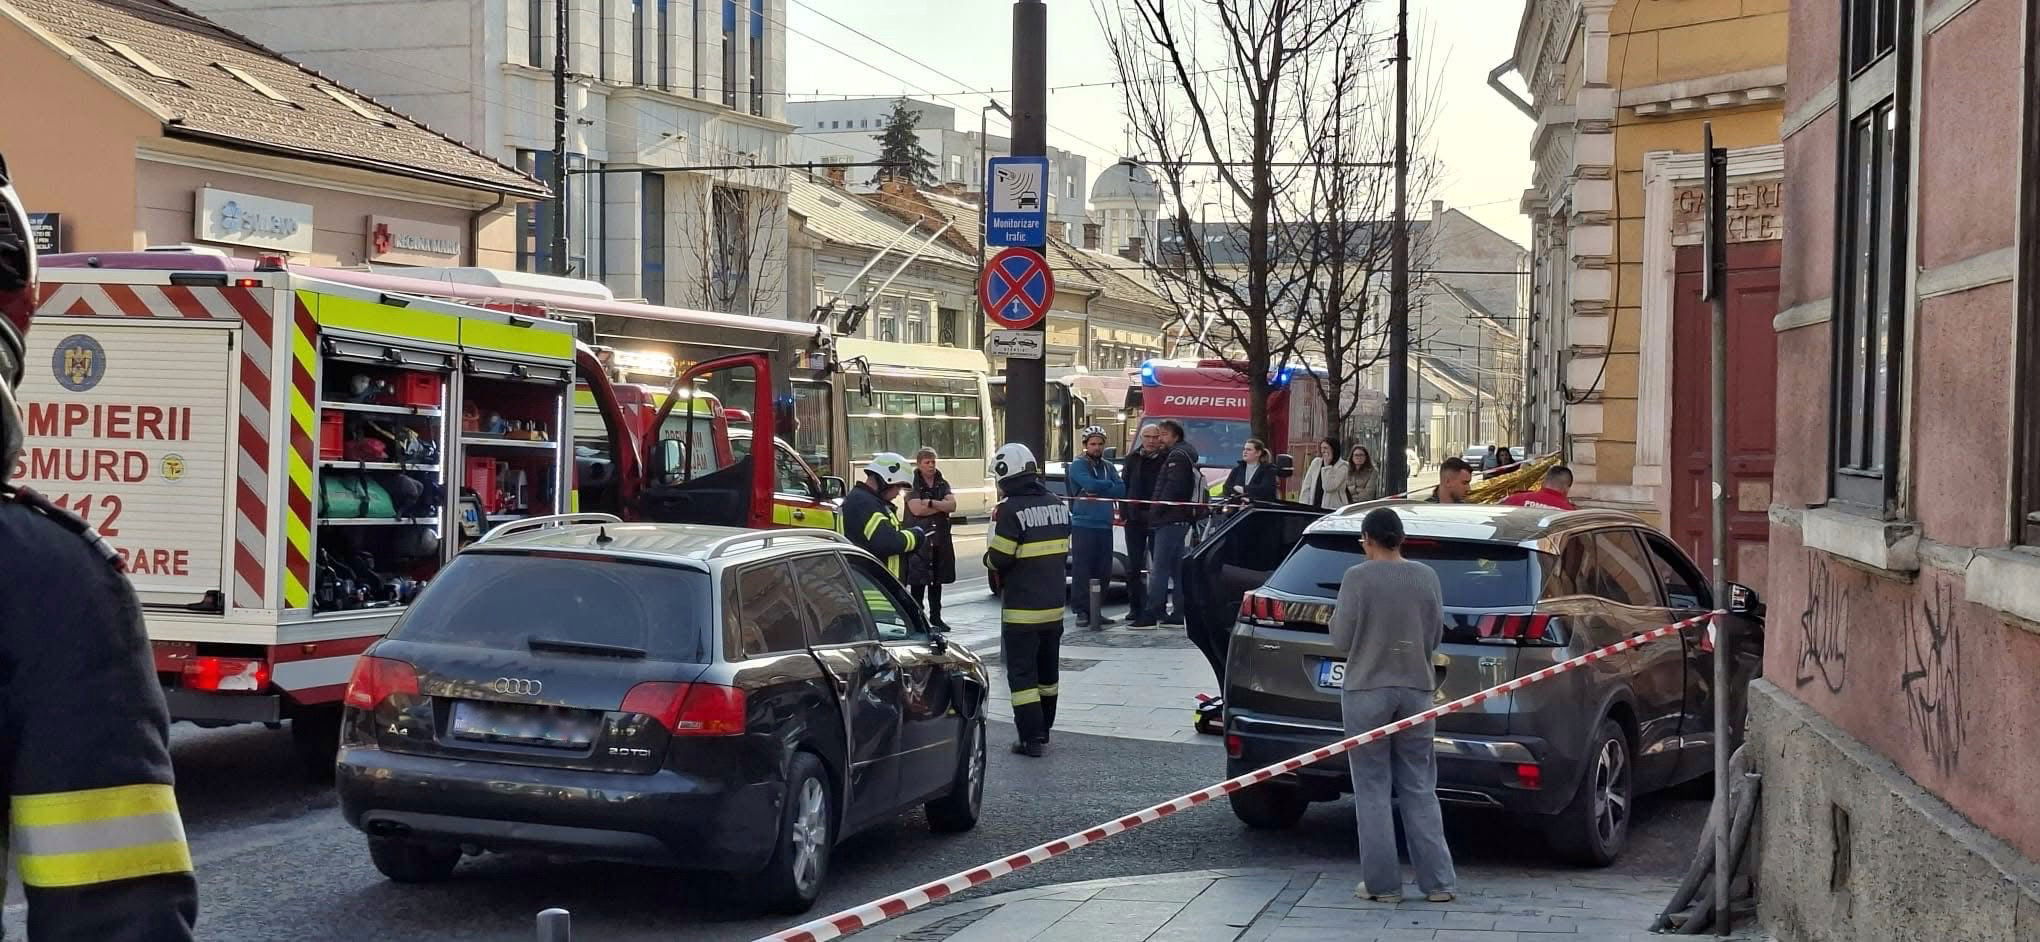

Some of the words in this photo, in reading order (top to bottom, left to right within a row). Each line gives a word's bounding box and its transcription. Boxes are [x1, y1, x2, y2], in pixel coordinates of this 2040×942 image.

[993, 217, 1040, 229] Monitorizare
[1006, 231, 1026, 242] trafic
[1163, 395, 1247, 408] POMPIERII
[18, 402, 191, 441] MPIERII
